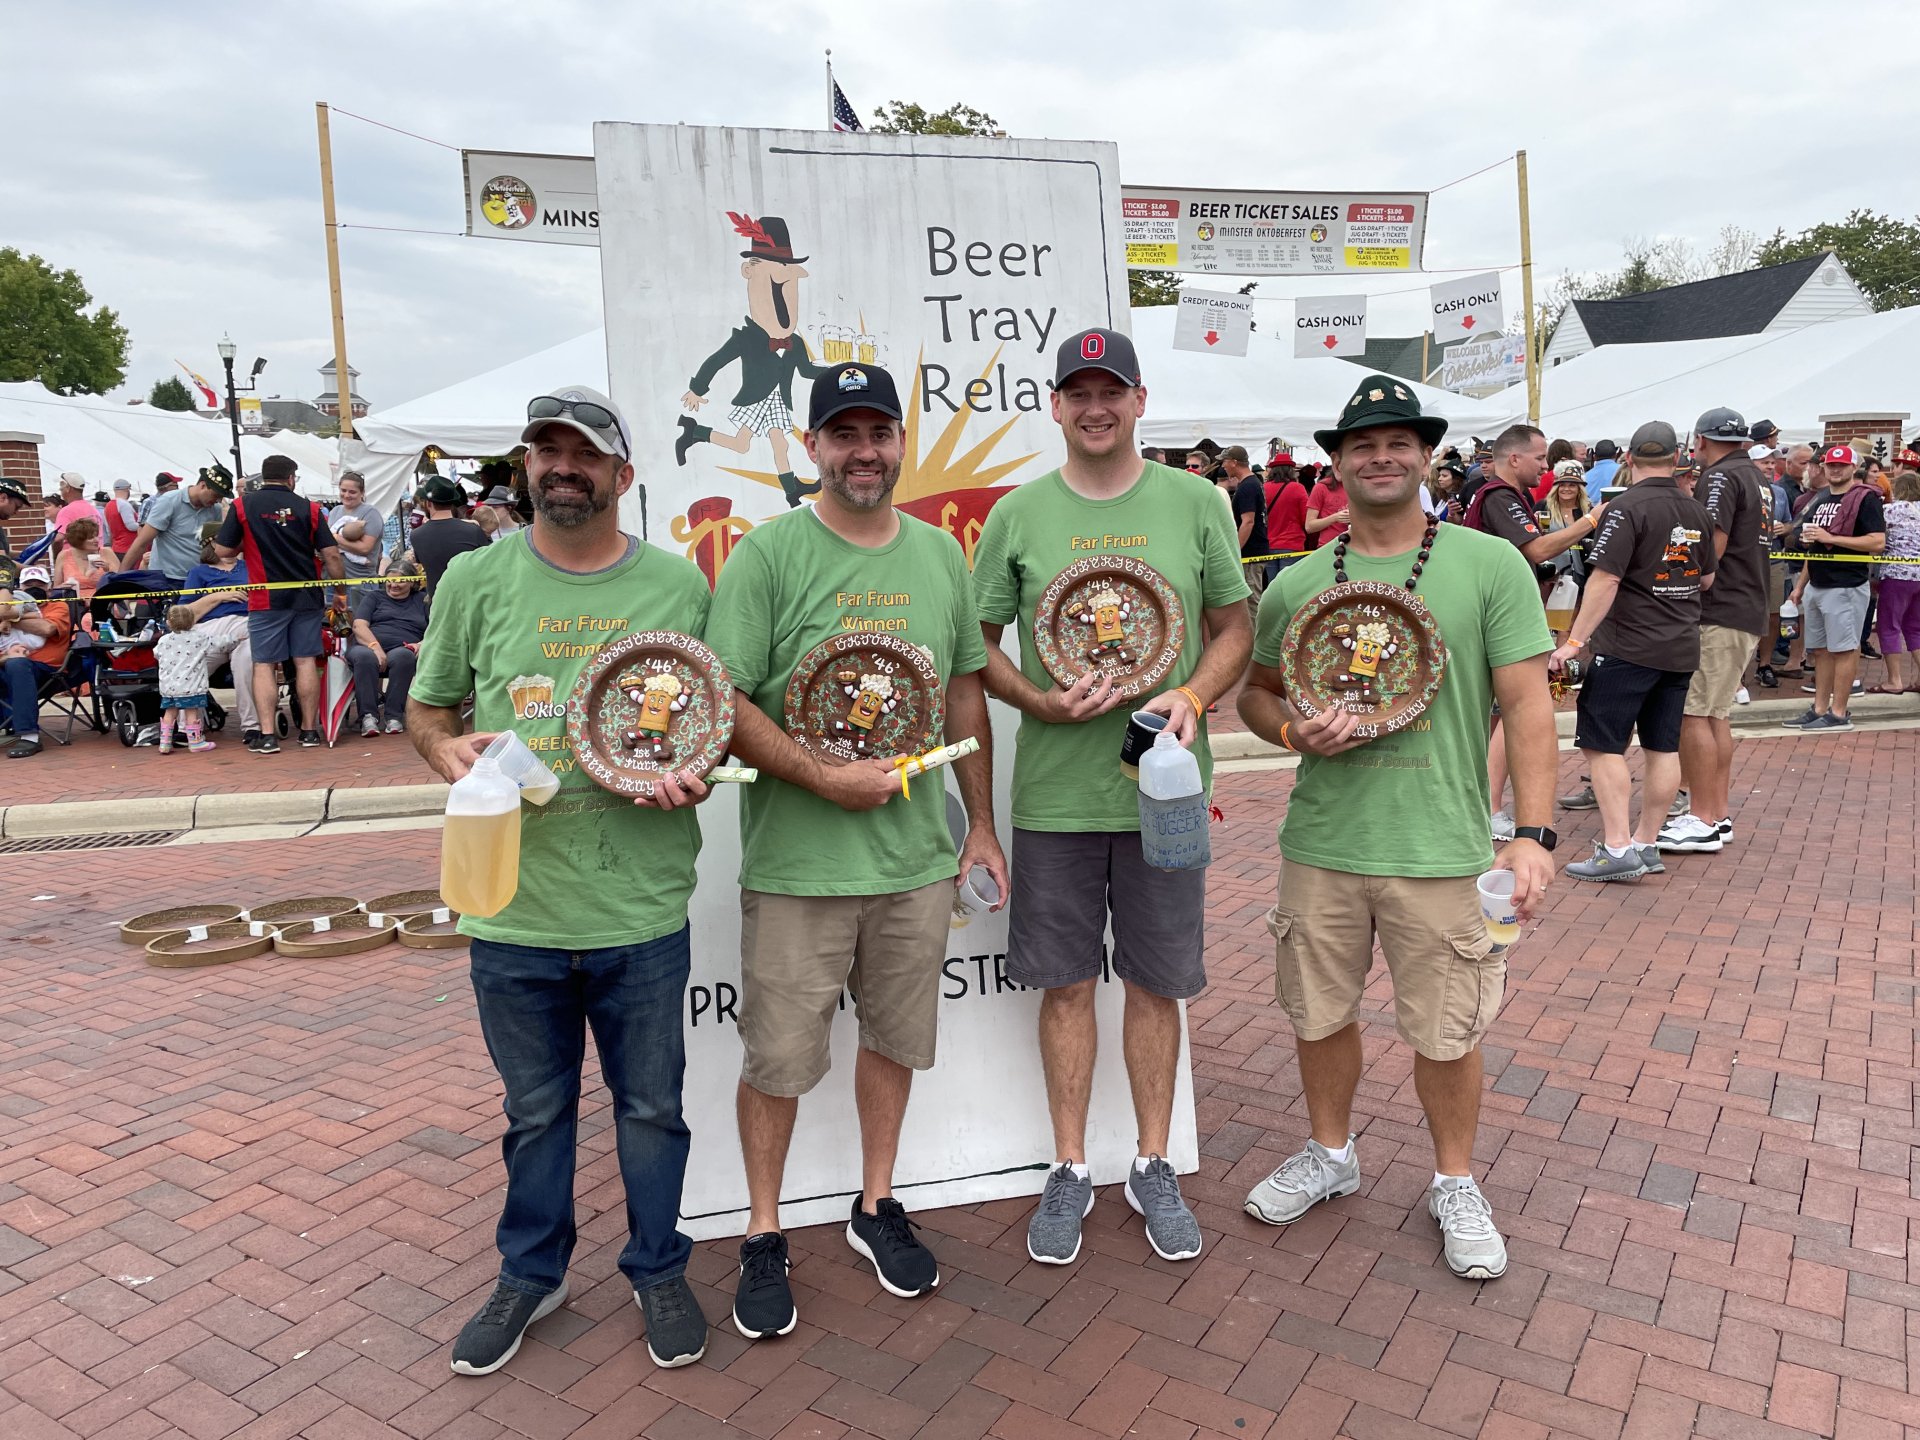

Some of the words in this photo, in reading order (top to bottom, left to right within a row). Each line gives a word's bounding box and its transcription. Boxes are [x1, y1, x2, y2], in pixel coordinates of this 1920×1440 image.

[1190, 203, 1230, 218] BEER
[1234, 204, 1289, 220] TICKET
[1292, 205, 1339, 220] SALES
[1220, 227, 1253, 238] MINSTER
[1256, 228, 1306, 238] OKTOBERFEST
[926, 226, 1052, 278] Beer
[1182, 296, 1208, 306] CREDIT
[1210, 300, 1229, 308] CARD
[1231, 302, 1250, 310] ONLY
[1434, 299, 1465, 314] CASH
[1468, 291, 1499, 307] ONLY
[924, 294, 1057, 354] Tray
[1297, 316, 1329, 328] CASH
[1332, 314, 1365, 327] ONLY
[1446, 344, 1480, 359] WELCOME
[1482, 344, 1491, 354] TO
[1071, 536, 1099, 550] Far
[1103, 534, 1148, 548] Frum
[836, 591, 863, 608] Far
[867, 590, 910, 607] Frum
[538, 616, 572, 633] Far
[577, 615, 629, 632] Frum
[841, 616, 908, 632] Winnen
[542, 641, 605, 659] Winne
[1384, 754, 1432, 770] Sound
[556, 785, 591, 796] ponsored
